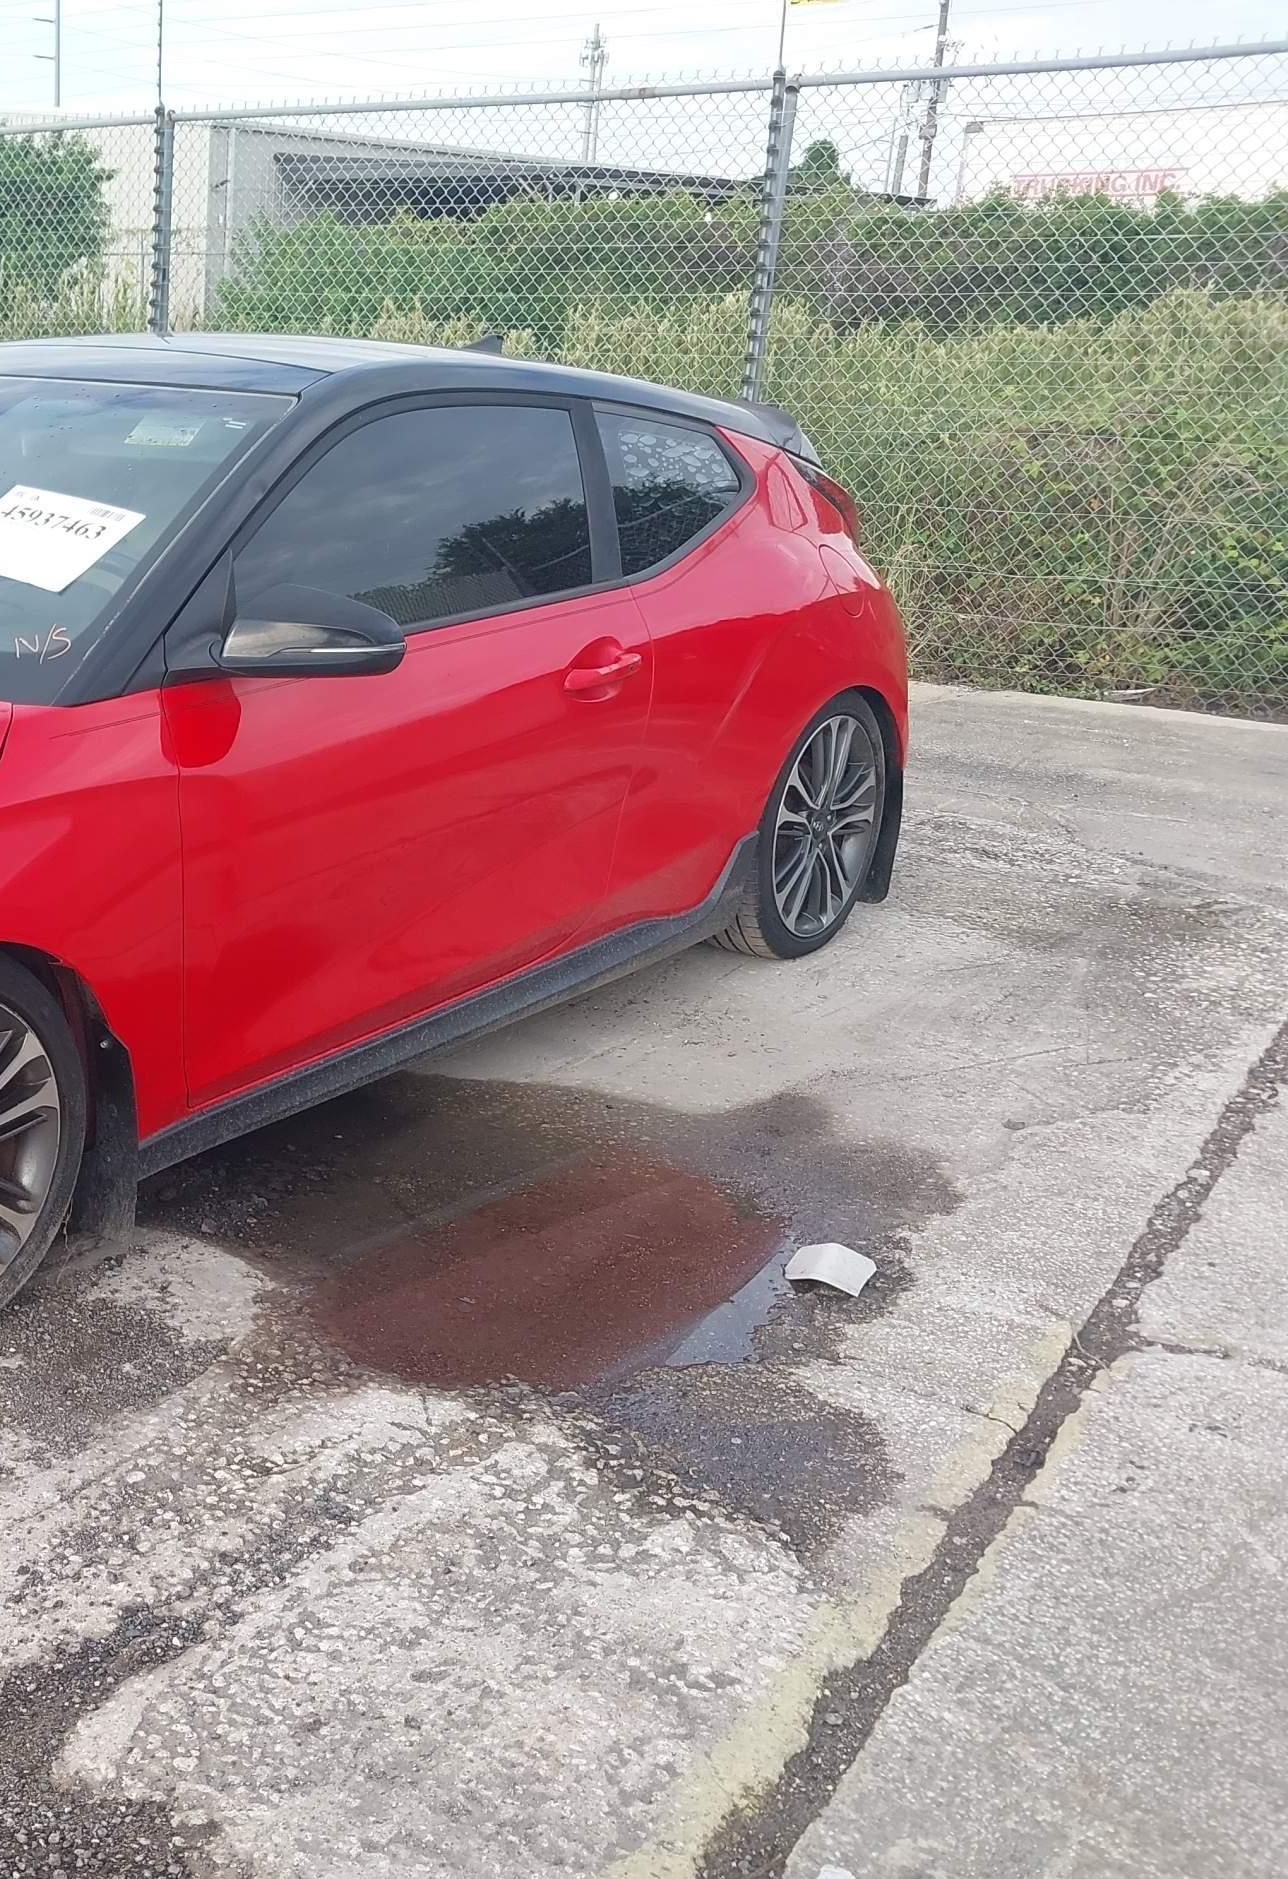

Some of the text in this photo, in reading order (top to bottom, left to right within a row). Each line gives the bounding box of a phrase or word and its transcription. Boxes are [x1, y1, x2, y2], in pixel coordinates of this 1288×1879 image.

[1015, 176, 1127, 195] TRUKING
[1, 505, 107, 540] 45937463
[15, 623, 72, 664] N/S
